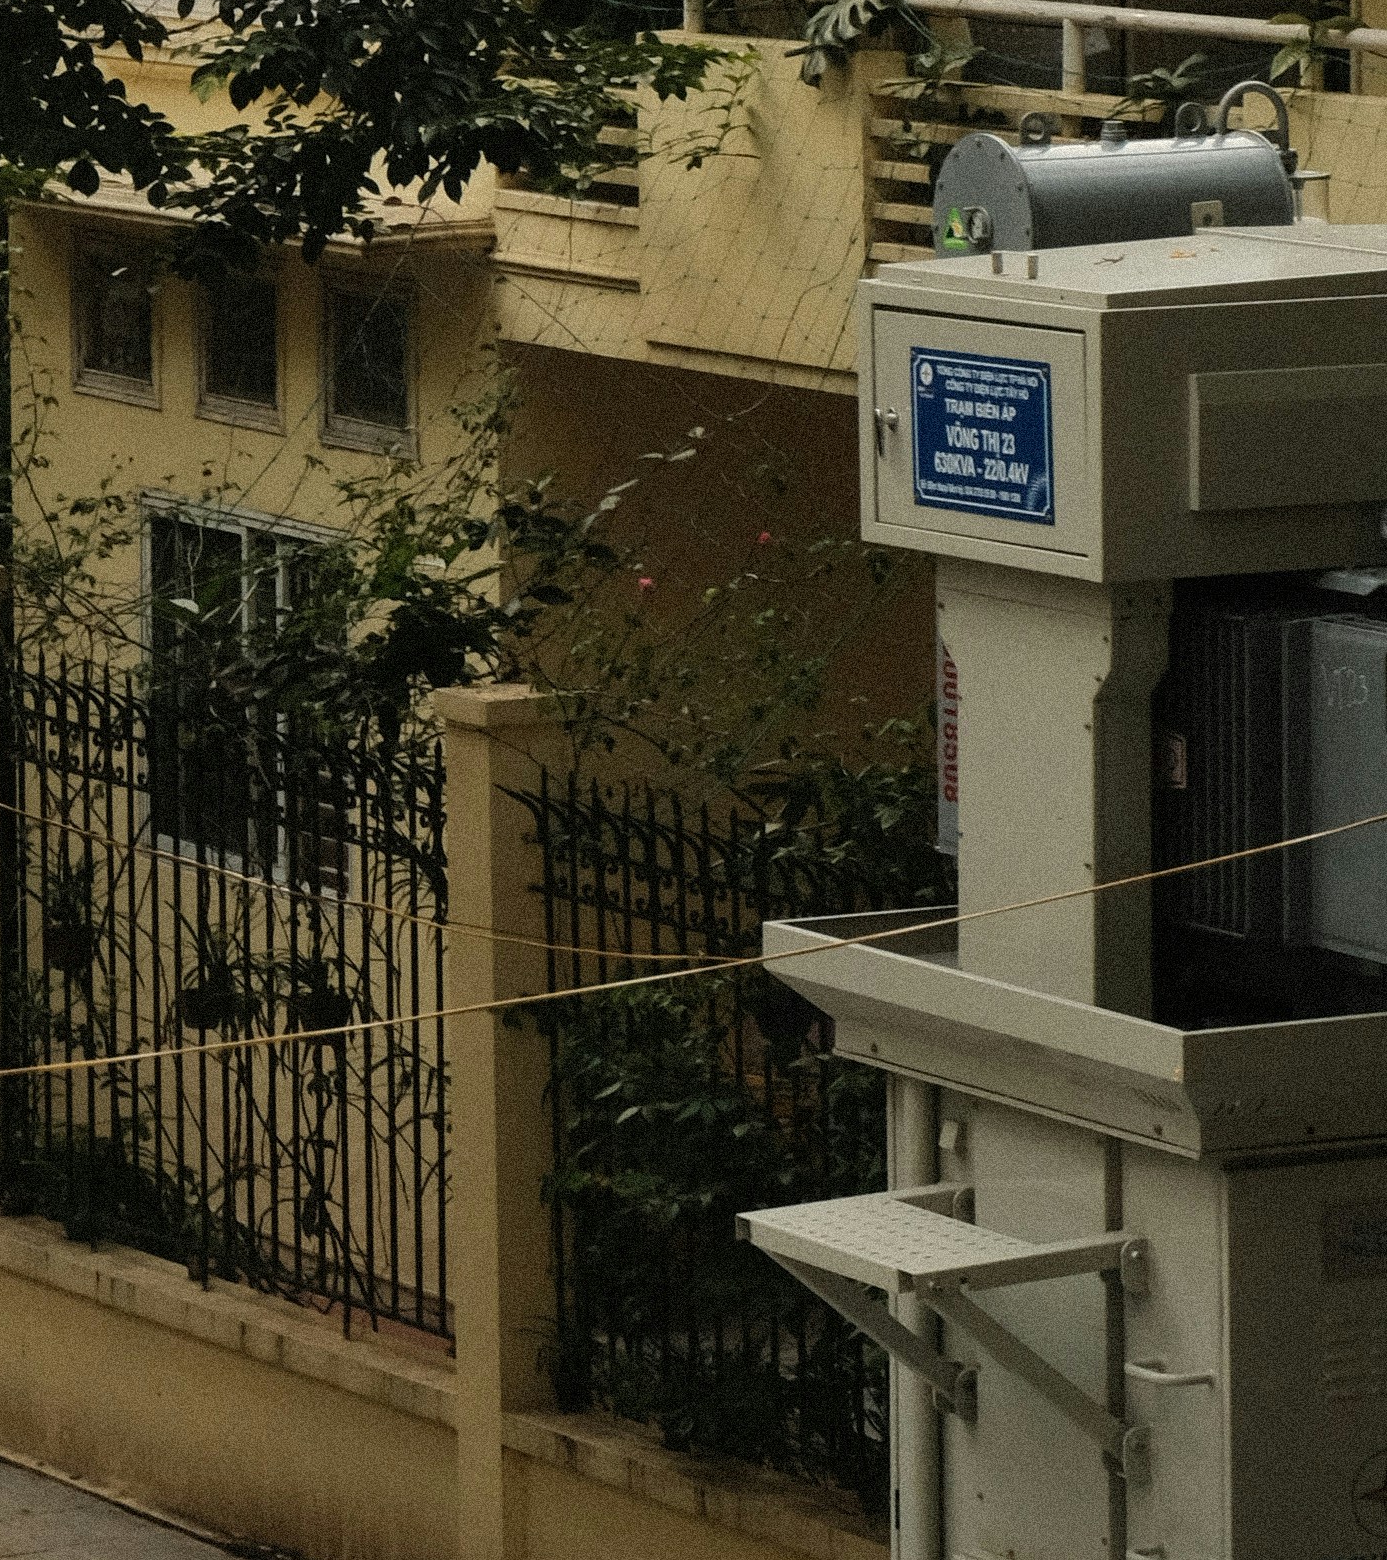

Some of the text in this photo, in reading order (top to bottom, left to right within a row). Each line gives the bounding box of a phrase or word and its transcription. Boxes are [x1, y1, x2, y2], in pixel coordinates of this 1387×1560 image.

[945, 397, 974, 419] TRẠM
[981, 429, 1000, 458] THỊ
[1001, 433, 1016, 455] 23
